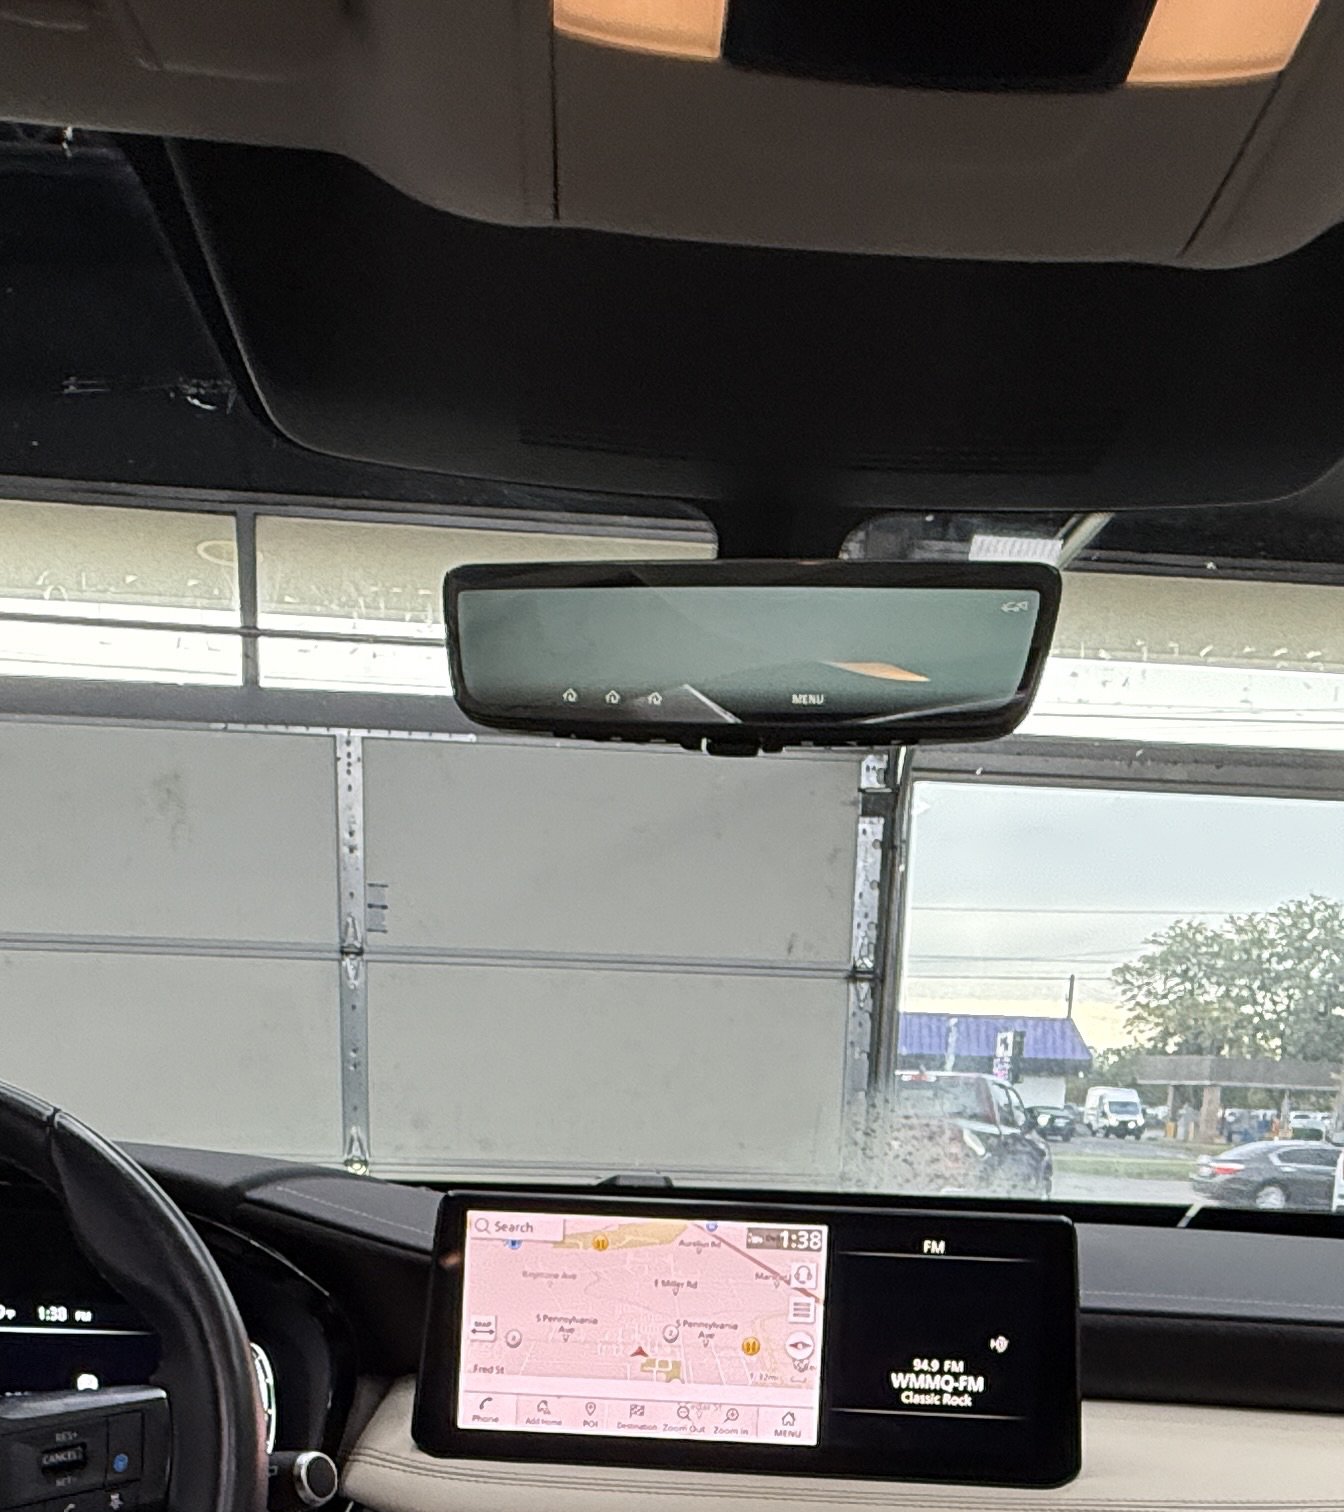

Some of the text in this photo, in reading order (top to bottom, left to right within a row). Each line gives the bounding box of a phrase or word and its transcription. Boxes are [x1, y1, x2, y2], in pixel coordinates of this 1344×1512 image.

[792, 694, 824, 704] MENU
[494, 1220, 533, 1233] Search
[779, 1230, 822, 1249] 1:38
[923, 1240, 946, 1254] FM
[687, 1281, 698, 1289] Rd
[543, 1314, 599, 1325] Pennsylvania
[683, 1320, 738, 1331] Pennsylvania
[698, 1331, 715, 1339] Ave
[495, 1366, 505, 1374] St
[913, 1358, 964, 1373] 94.9 FM
[891, 1372, 985, 1392] WMMQ-FM
[901, 1391, 972, 1407] Classic Rock
[472, 1415, 499, 1423] Phone
[617, 1422, 657, 1430] Destination
[662, 1424, 705, 1433] Zoom Out
[714, 1426, 738, 1435] Zoom
[774, 1429, 801, 1438] MENU
[42, 1446, 82, 1465] CANCEL
